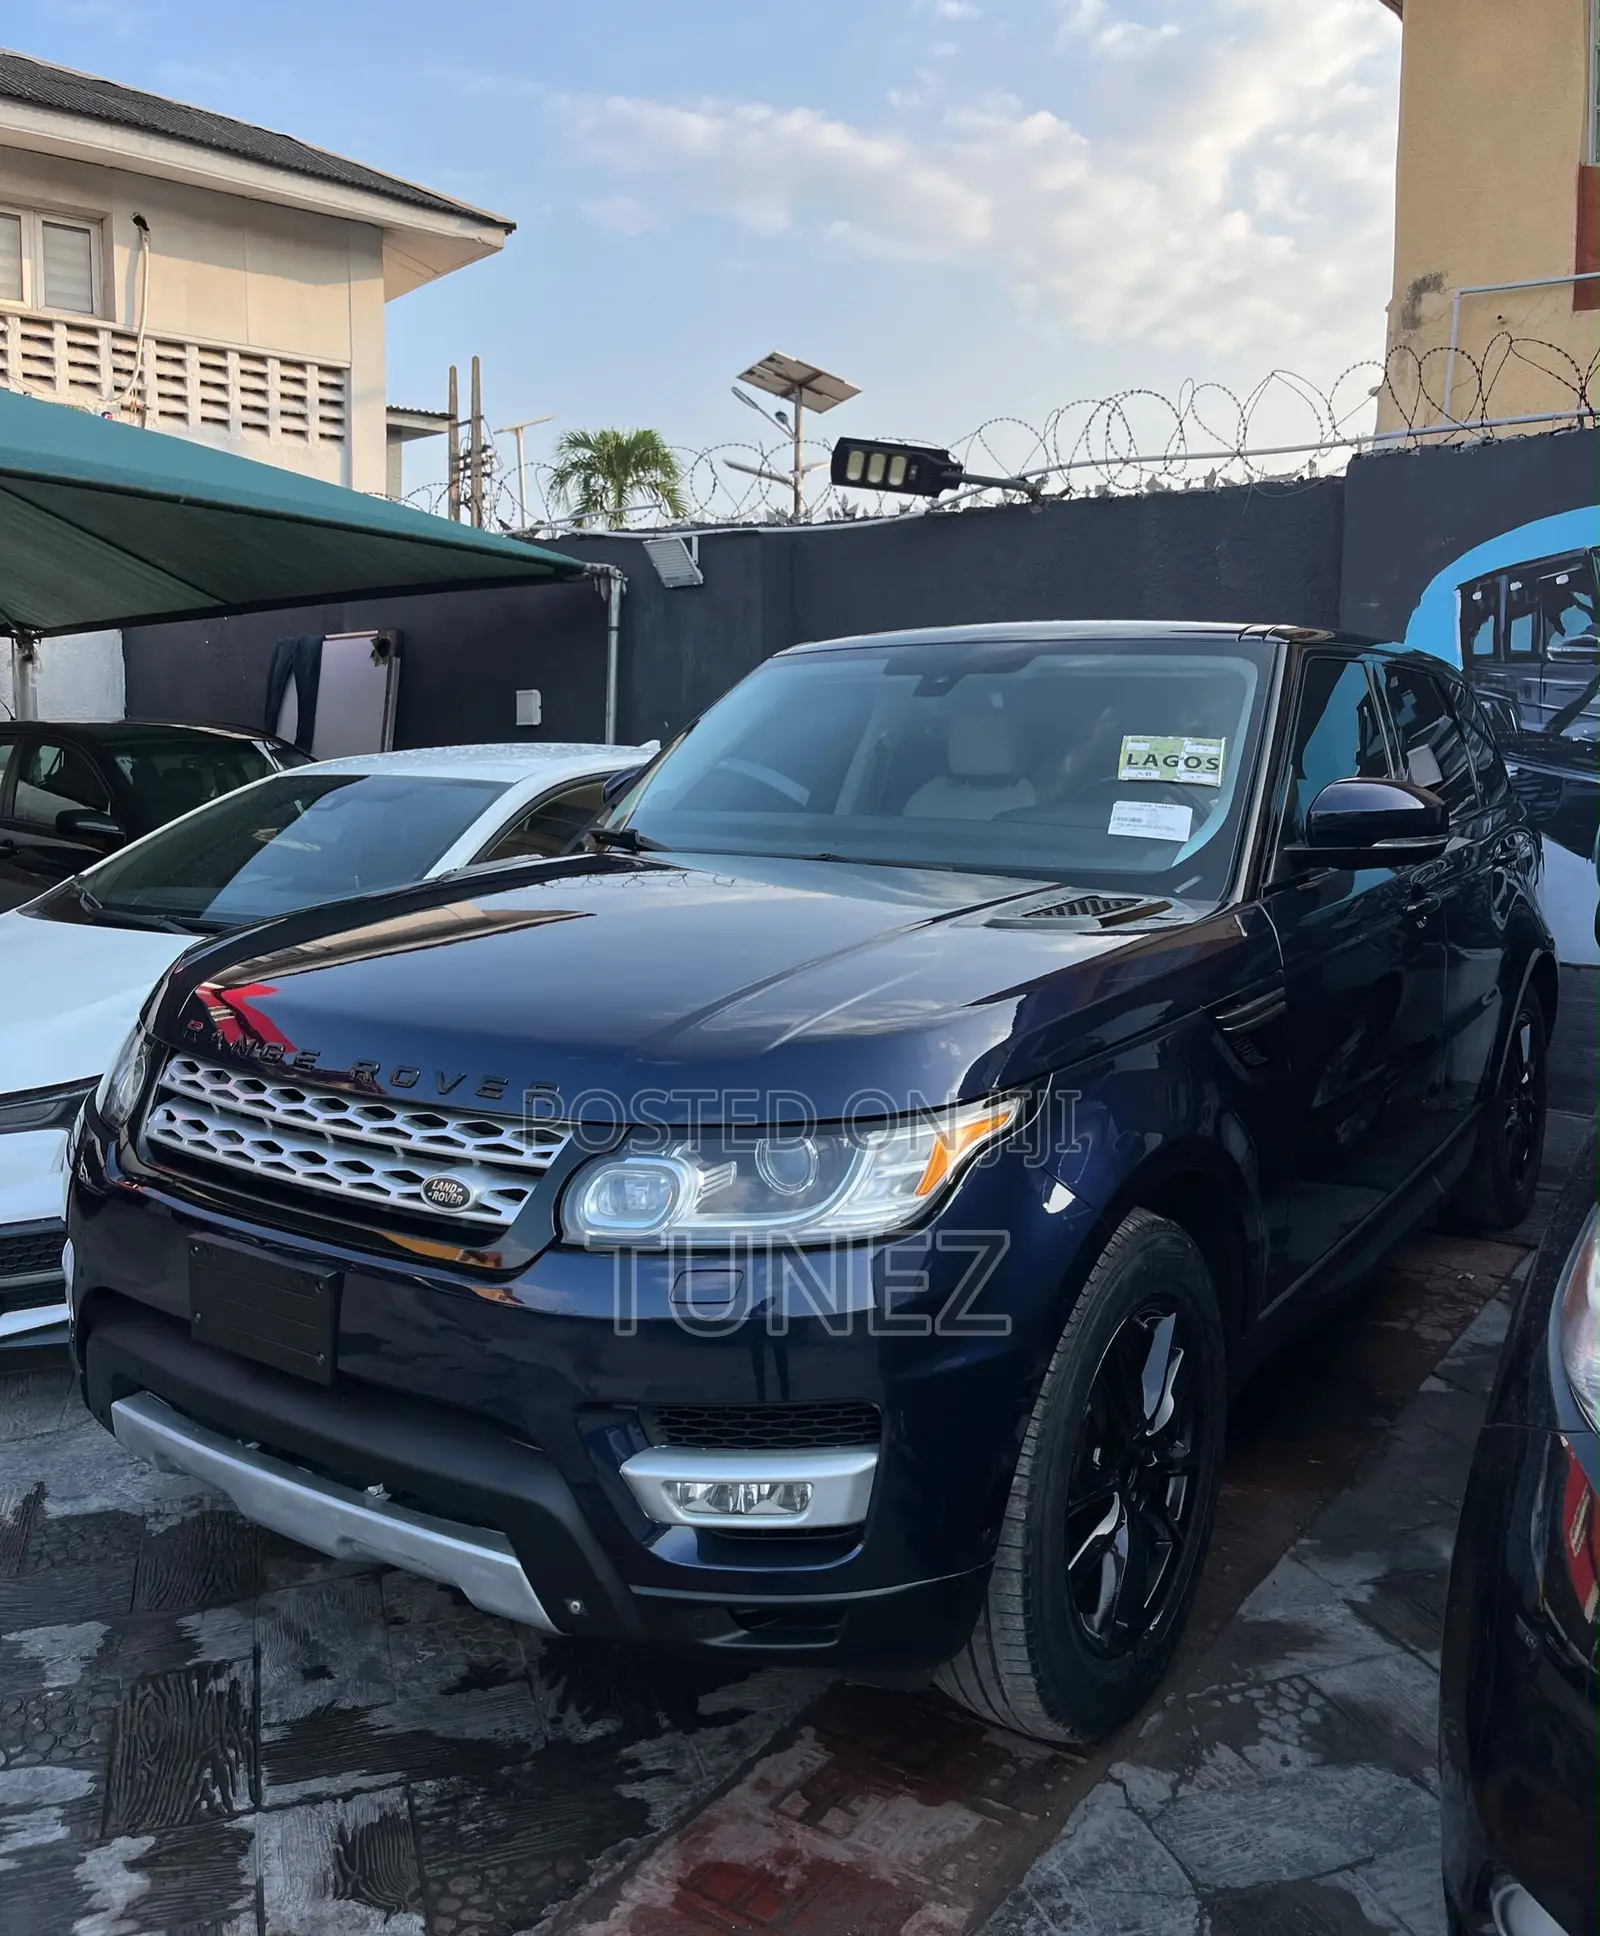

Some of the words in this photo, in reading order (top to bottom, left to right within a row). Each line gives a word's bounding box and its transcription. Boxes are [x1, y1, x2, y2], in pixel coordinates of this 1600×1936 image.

[1126, 753, 1219, 770] LAGOS
[181, 1019, 321, 1072] RANGE
[349, 1058, 561, 1107] ROVER
[431, 1180, 458, 1194] LAND
[431, 1190, 464, 1205] ROVER
